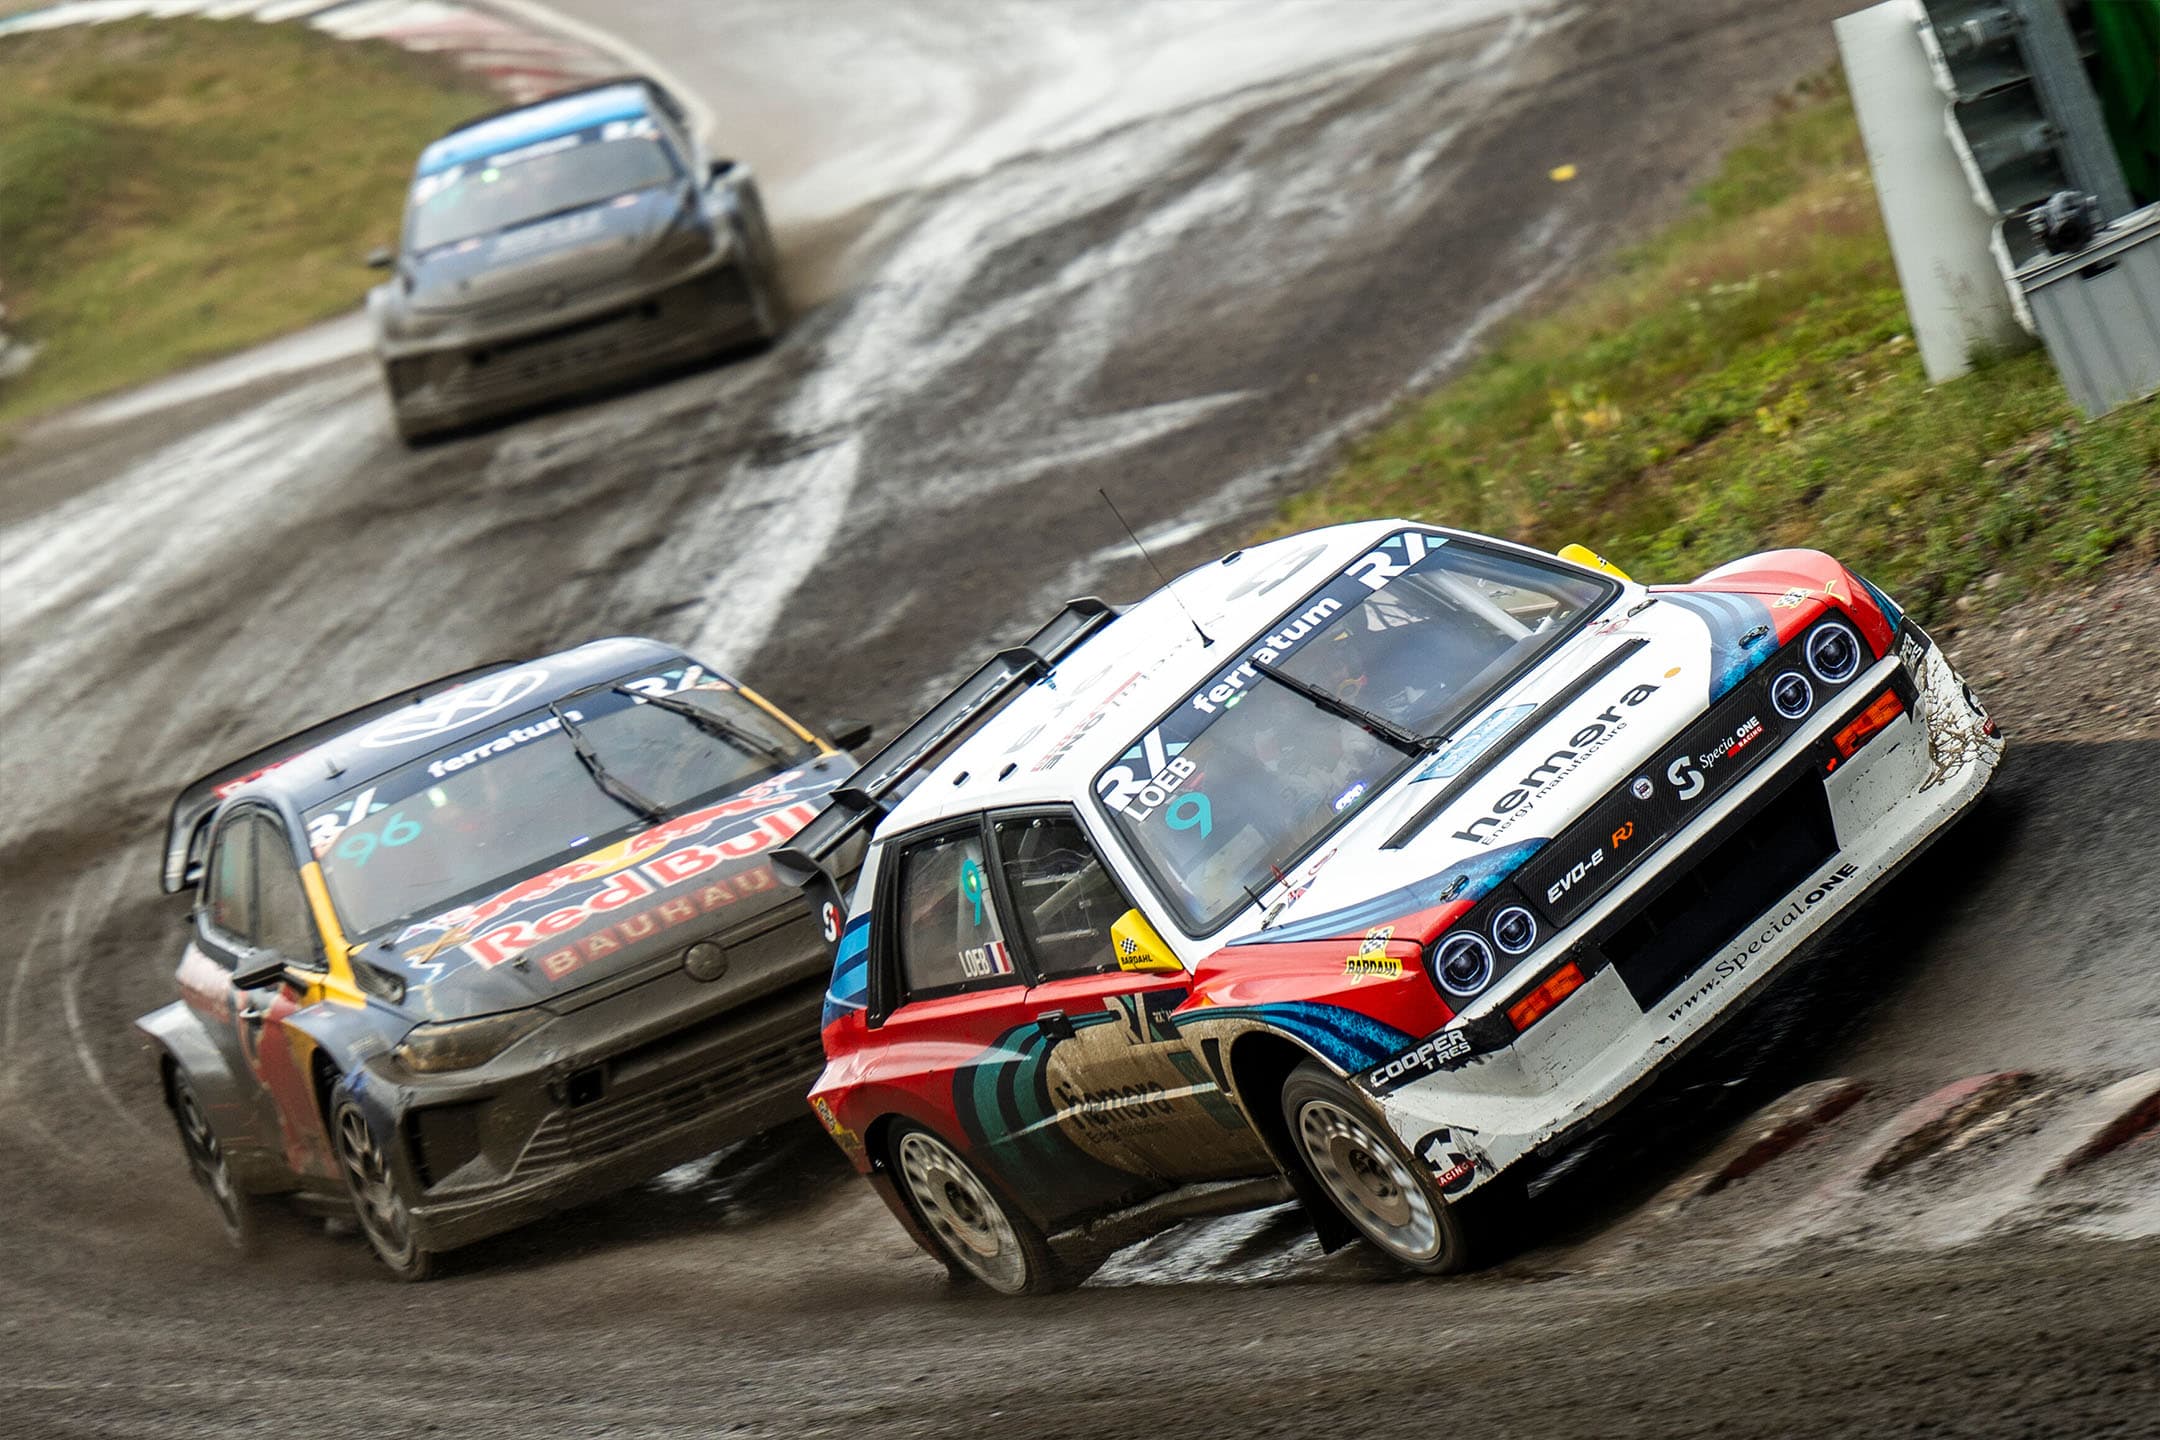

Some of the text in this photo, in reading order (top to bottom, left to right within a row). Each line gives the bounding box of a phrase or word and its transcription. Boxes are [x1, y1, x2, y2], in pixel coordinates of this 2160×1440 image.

[1193, 597, 1342, 714] ferratum
[427, 709, 584, 778] ferratum
[1736, 715, 1760, 738] ONE
[1123, 756, 1197, 822] LOEB
[1481, 801, 1535, 846] Energy
[1535, 721, 1627, 799] manufacture
[336, 811, 424, 868] 96
[1165, 791, 1213, 840] 9
[462, 801, 820, 970] Red Bull
[961, 858, 982, 927] 9
[1547, 847, 1604, 904] EVO-e
[958, 947, 991, 979] LOEB
[1120, 954, 1154, 966] BARDAHL
[1370, 1029, 1466, 1088] COOPER
[1422, 1041, 1472, 1071] TRES
